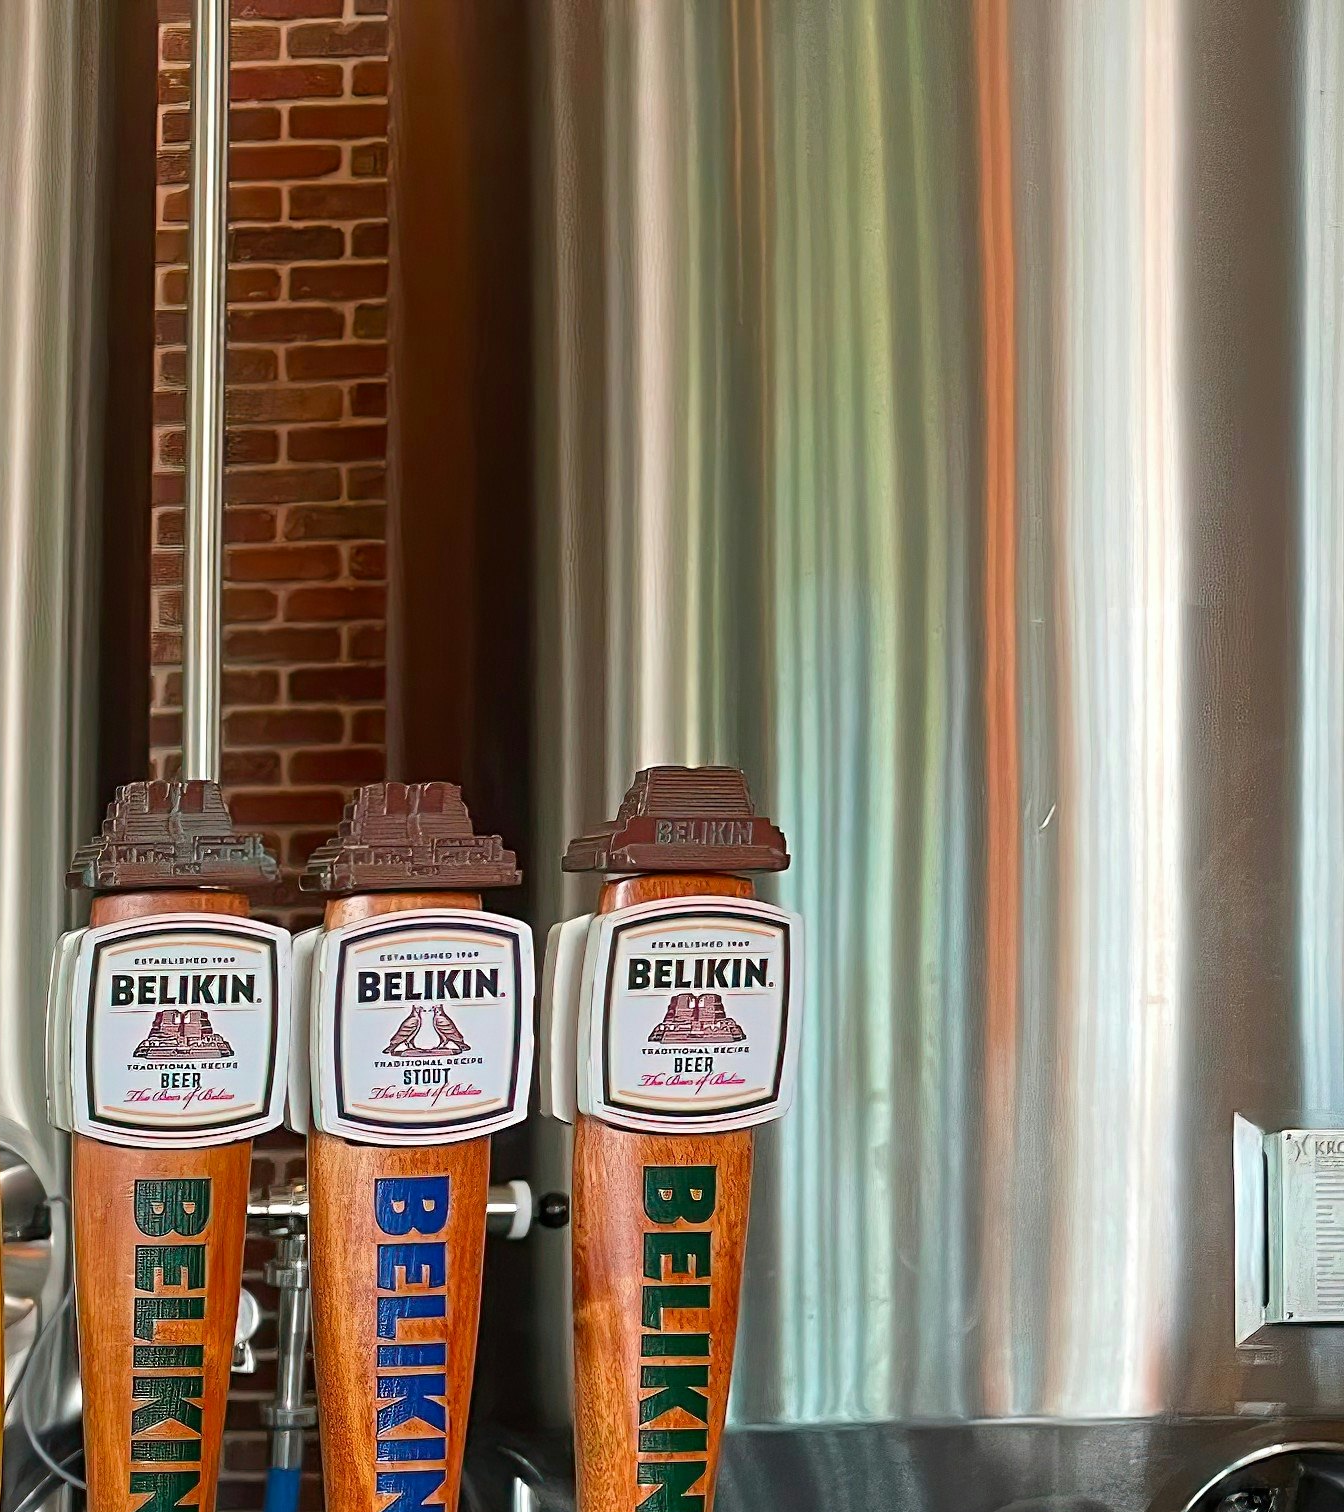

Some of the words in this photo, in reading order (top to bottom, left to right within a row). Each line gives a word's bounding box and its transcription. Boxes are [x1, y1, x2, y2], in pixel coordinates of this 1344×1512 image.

[656, 819, 753, 846] BELIKIN
[674, 1056, 713, 1073] BEER
[160, 1072, 202, 1089] BEER
[403, 1067, 451, 1086] STOUT
